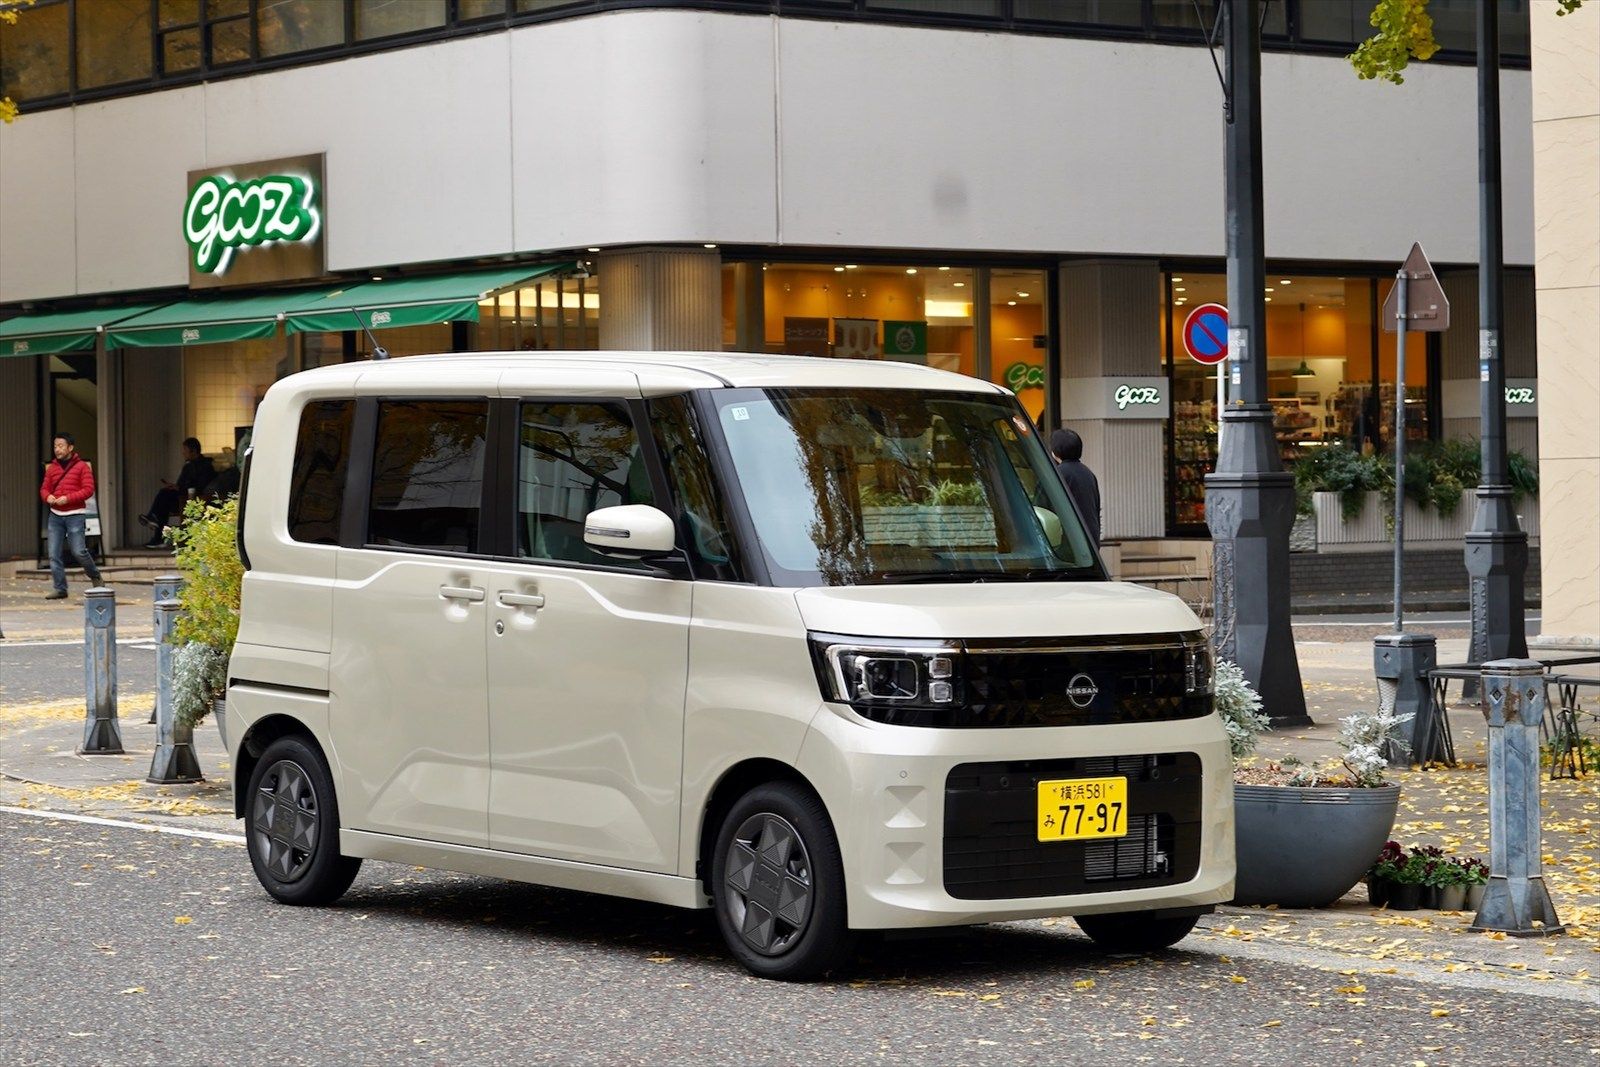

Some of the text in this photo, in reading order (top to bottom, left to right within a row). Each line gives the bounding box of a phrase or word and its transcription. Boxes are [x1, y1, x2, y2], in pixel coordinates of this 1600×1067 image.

[1066, 687, 1098, 695] NISSAN
[1043, 802, 1122, 835] み 77-97
